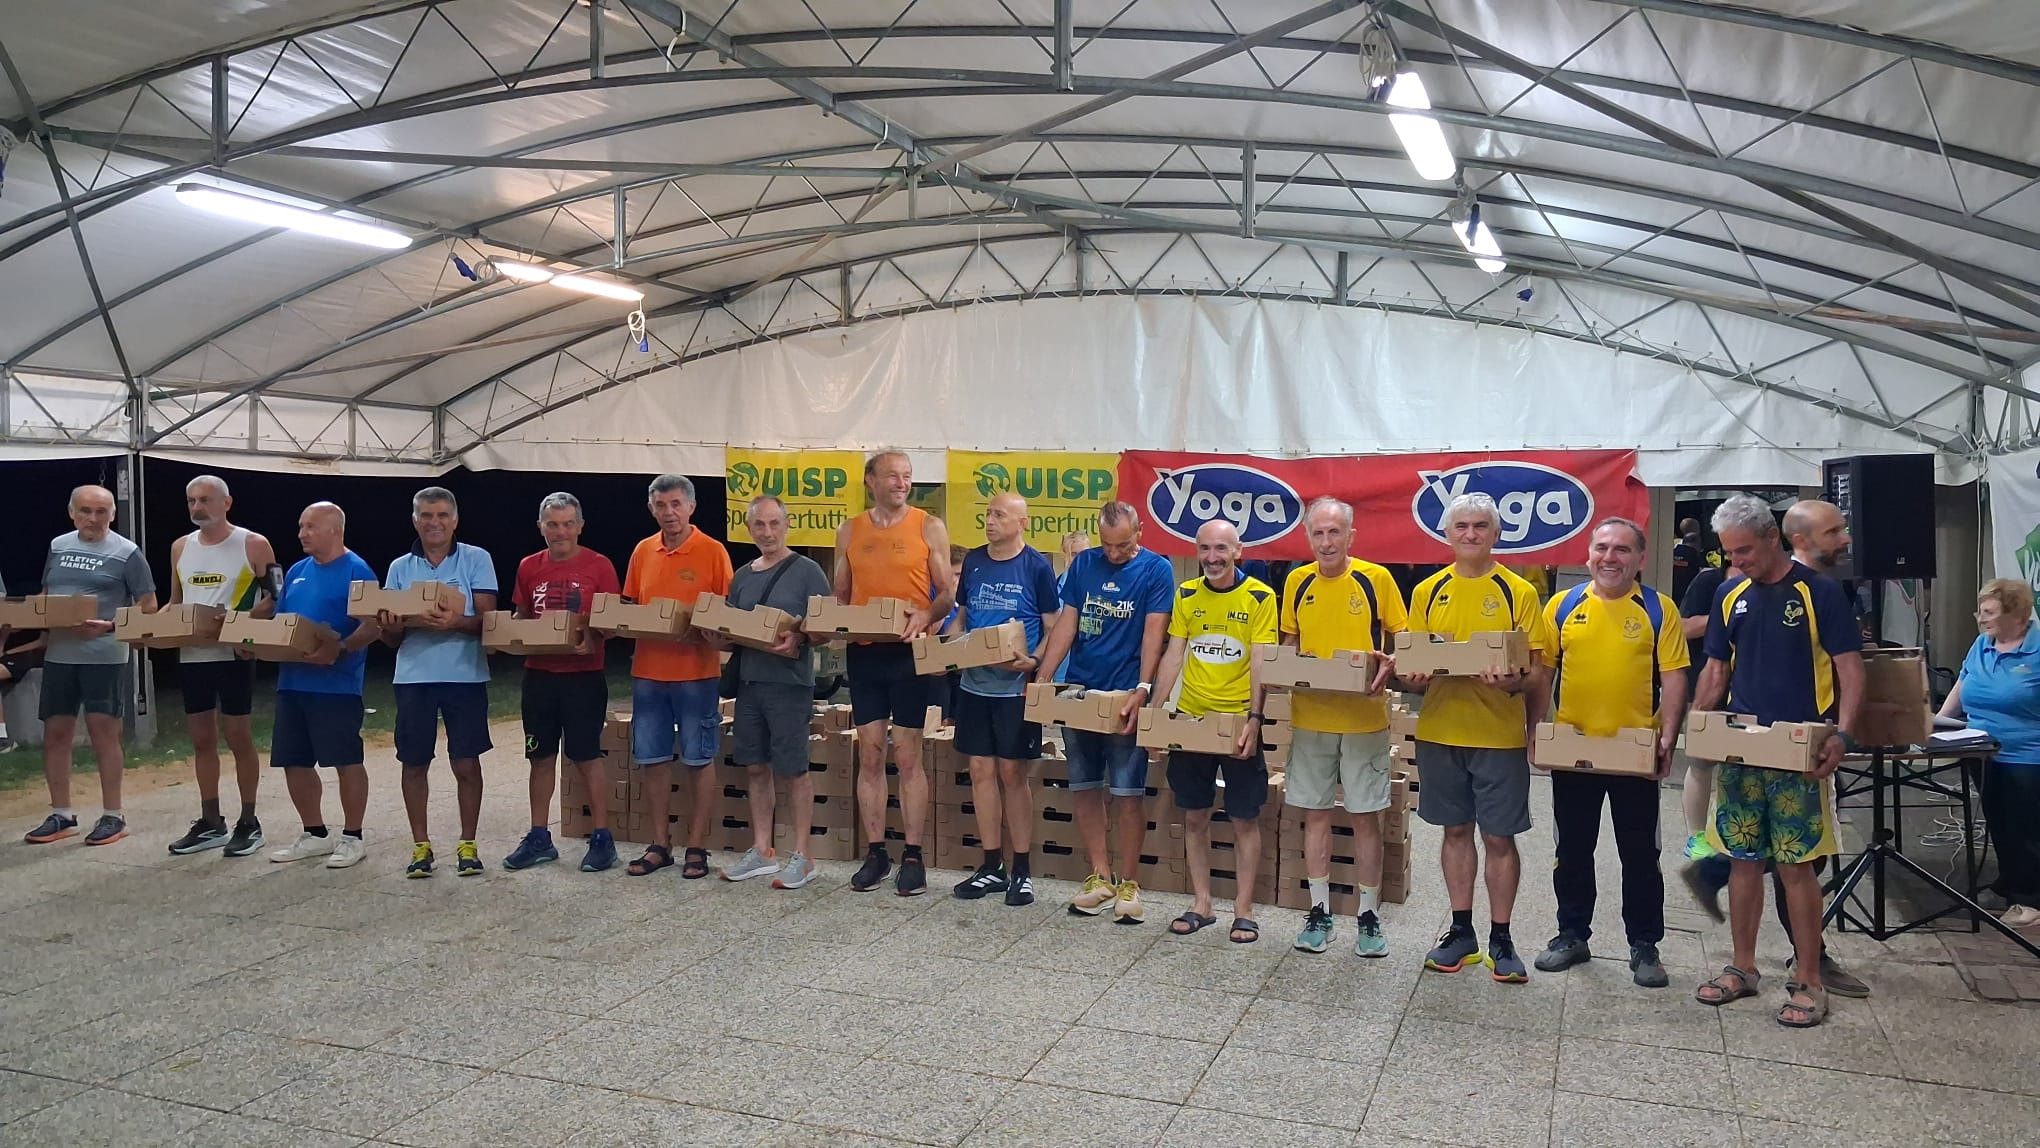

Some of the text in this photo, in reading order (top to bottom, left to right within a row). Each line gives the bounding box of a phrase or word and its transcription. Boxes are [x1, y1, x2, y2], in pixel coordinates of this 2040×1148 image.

[1164, 473, 1287, 537] Yoga
[1431, 473, 1574, 541] Yga
[61, 555, 103, 566] ATLETICA
[1116, 600, 1135, 610] 21K
